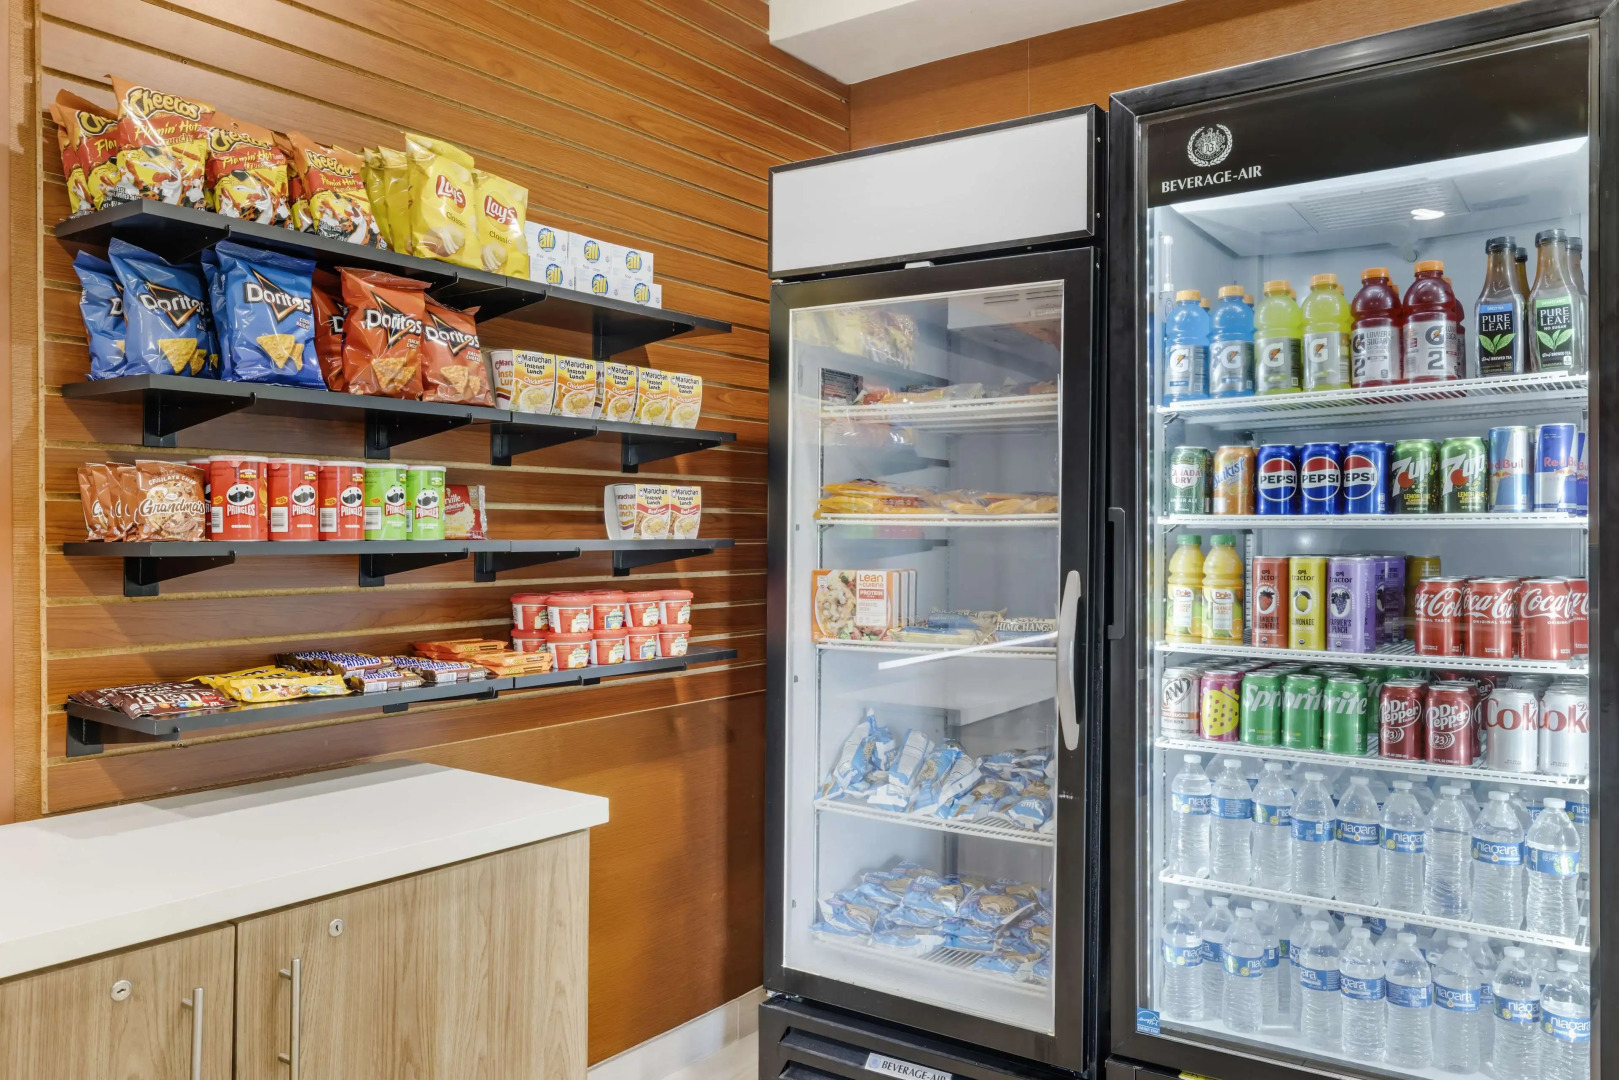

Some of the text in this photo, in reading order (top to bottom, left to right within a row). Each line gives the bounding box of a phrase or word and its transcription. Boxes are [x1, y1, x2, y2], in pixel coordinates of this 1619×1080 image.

[127, 88, 200, 120] Cheetos
[179, 120, 202, 132] Hot
[1161, 165, 1263, 194] BEVERAGE-AIR
[437, 175, 463, 204] Lay's
[485, 196, 516, 223] Lay's
[489, 231, 512, 245] Classic
[539, 231, 554, 248] all
[584, 243, 599, 260] all
[627, 254, 641, 270] all
[547, 267, 562, 284] all
[592, 277, 607, 293] all
[247, 283, 312, 313] Doritos
[635, 285, 649, 301] all
[141, 293, 205, 316] Doritos
[1540, 307, 1569, 317] PURE
[366, 309, 422, 335] Doritos
[1482, 314, 1510, 323] PURE
[424, 326, 480, 348] Doritos
[1425, 325, 1444, 346] G
[1221, 345, 1241, 369] G
[1262, 342, 1285, 367] G
[1308, 337, 1329, 363] G
[522, 354, 552, 364] Maruchan
[524, 362, 545, 370] Instant
[564, 360, 594, 370] Maruchan
[1170, 348, 1189, 373] G
[1427, 350, 1444, 371] 2
[611, 366, 634, 376] Maruchan
[646, 371, 668, 380] Maruchan
[676, 376, 699, 385] Maruchan
[1502, 458, 1523, 469] Bull
[1543, 456, 1567, 467] Red
[181, 476, 197, 485] CHIP
[1260, 473, 1296, 485] PEPSI
[1302, 472, 1339, 484] PEPSI
[1343, 471, 1375, 482] EPSI
[643, 487, 668, 495] Maruchan
[139, 498, 205, 517] Grandma's
[227, 504, 256, 517] PRINGLES
[860, 574, 884, 583] Lean
[1175, 590, 1191, 598] Dole
[1215, 591, 1231, 599] Dole
[996, 622, 1054, 632] HIMICHANGA
[1380, 701, 1419, 725] Pepper
[1391, 699, 1409, 713] Dr
[1440, 704, 1458, 718] Dr
[1426, 706, 1469, 731] Pepper
[1435, 735, 1445, 745] 23
[1340, 822, 1377, 837] niagara
[1476, 841, 1518, 857] niagara
[1435, 986, 1473, 1002] niagara
